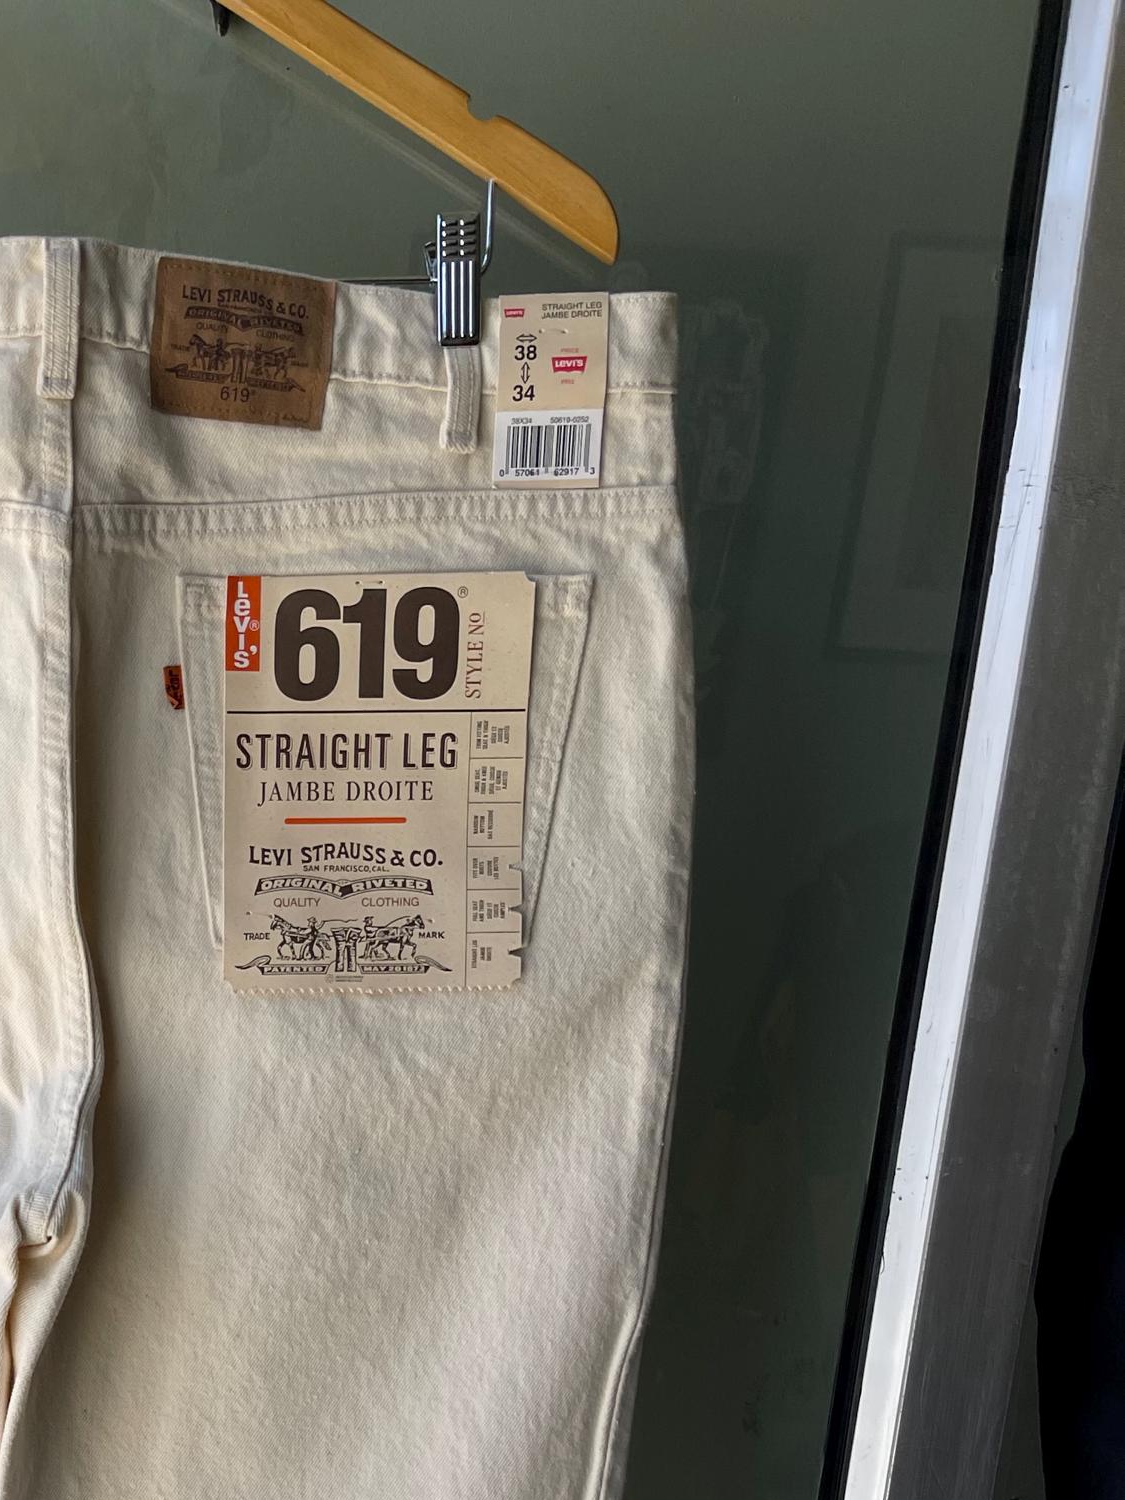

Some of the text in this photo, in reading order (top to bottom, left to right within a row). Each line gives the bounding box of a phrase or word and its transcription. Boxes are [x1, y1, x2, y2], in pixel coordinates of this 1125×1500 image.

[182, 285, 211, 303] LEVI
[217, 288, 273, 312] STRAUSS
[276, 302, 286, 314] &
[289, 303, 309, 319] CO.
[542, 301, 602, 311] STRAIGHT LEG
[541, 310, 602, 319] JAMBE DROITE
[514, 345, 537, 361] 38
[220, 386, 250, 402] 619
[512, 385, 535, 401] 34
[499, 469, 505, 477] 0
[515, 468, 540, 477] 57061
[554, 468, 579, 477] 62917
[274, 586, 461, 701] 619
[465, 641, 483, 699] STYLE
[236, 732, 458, 770] STRAIGHT LEG
[257, 780, 434, 807] JAMBE DROITE
[249, 842, 443, 867] LEVI STRAUSS & CO.
[261, 878, 429, 897] ORIGINAL RIVETED
[273, 897, 321, 908] QUALITY
[361, 897, 420, 907] CLOTHING
[244, 932, 271, 941] TRADE
[418, 931, 445, 939] MARK
